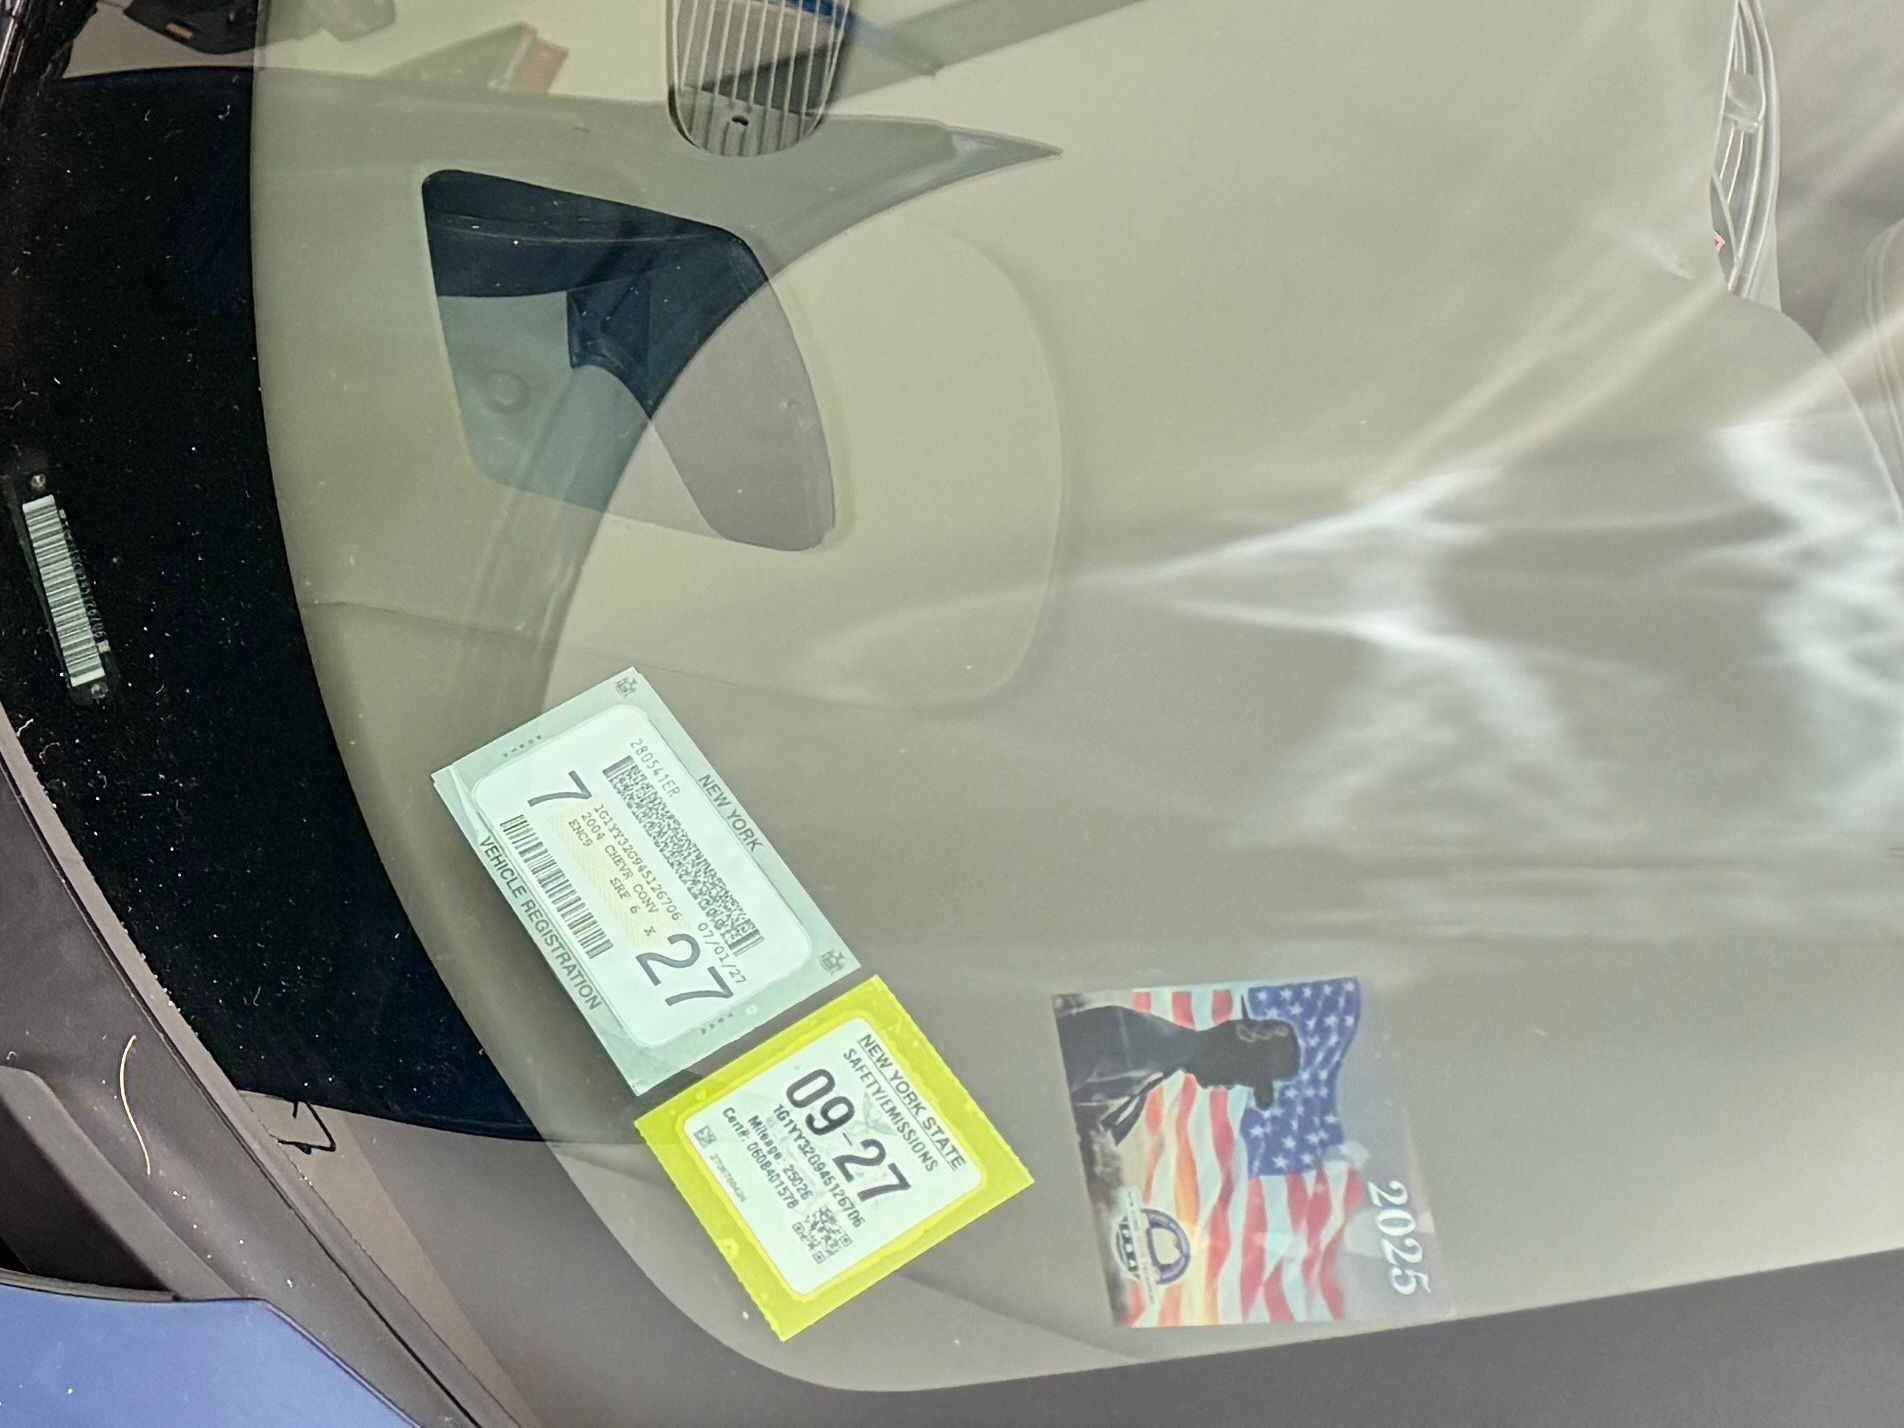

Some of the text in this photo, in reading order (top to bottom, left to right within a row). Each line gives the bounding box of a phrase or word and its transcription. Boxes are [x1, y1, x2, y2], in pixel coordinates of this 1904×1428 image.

[525, 768, 593, 809] 7
[629, 737, 681, 799] 280541ER
[696, 772, 764, 853] NEW YORK
[579, 809, 661, 917] 2004 CHEVR CONV
[477, 835, 528, 901] VEHICLE
[519, 897, 602, 1012] REGISTRATION
[626, 902, 642, 916] 6
[641, 924, 656, 938] X
[695, 920, 747, 987] 07/01/27
[633, 929, 735, 1011] 27
[720, 1105, 753, 1144] Cert#:
[781, 1064, 913, 1207] 09-27
[841, 1047, 939, 1174] SAFETY/EMISSIONS
[858, 1032, 967, 1171] NEW YORK STATE
[745, 1114, 814, 1202] Mileage: 25026
[1365, 1176, 1432, 1296] 2025
